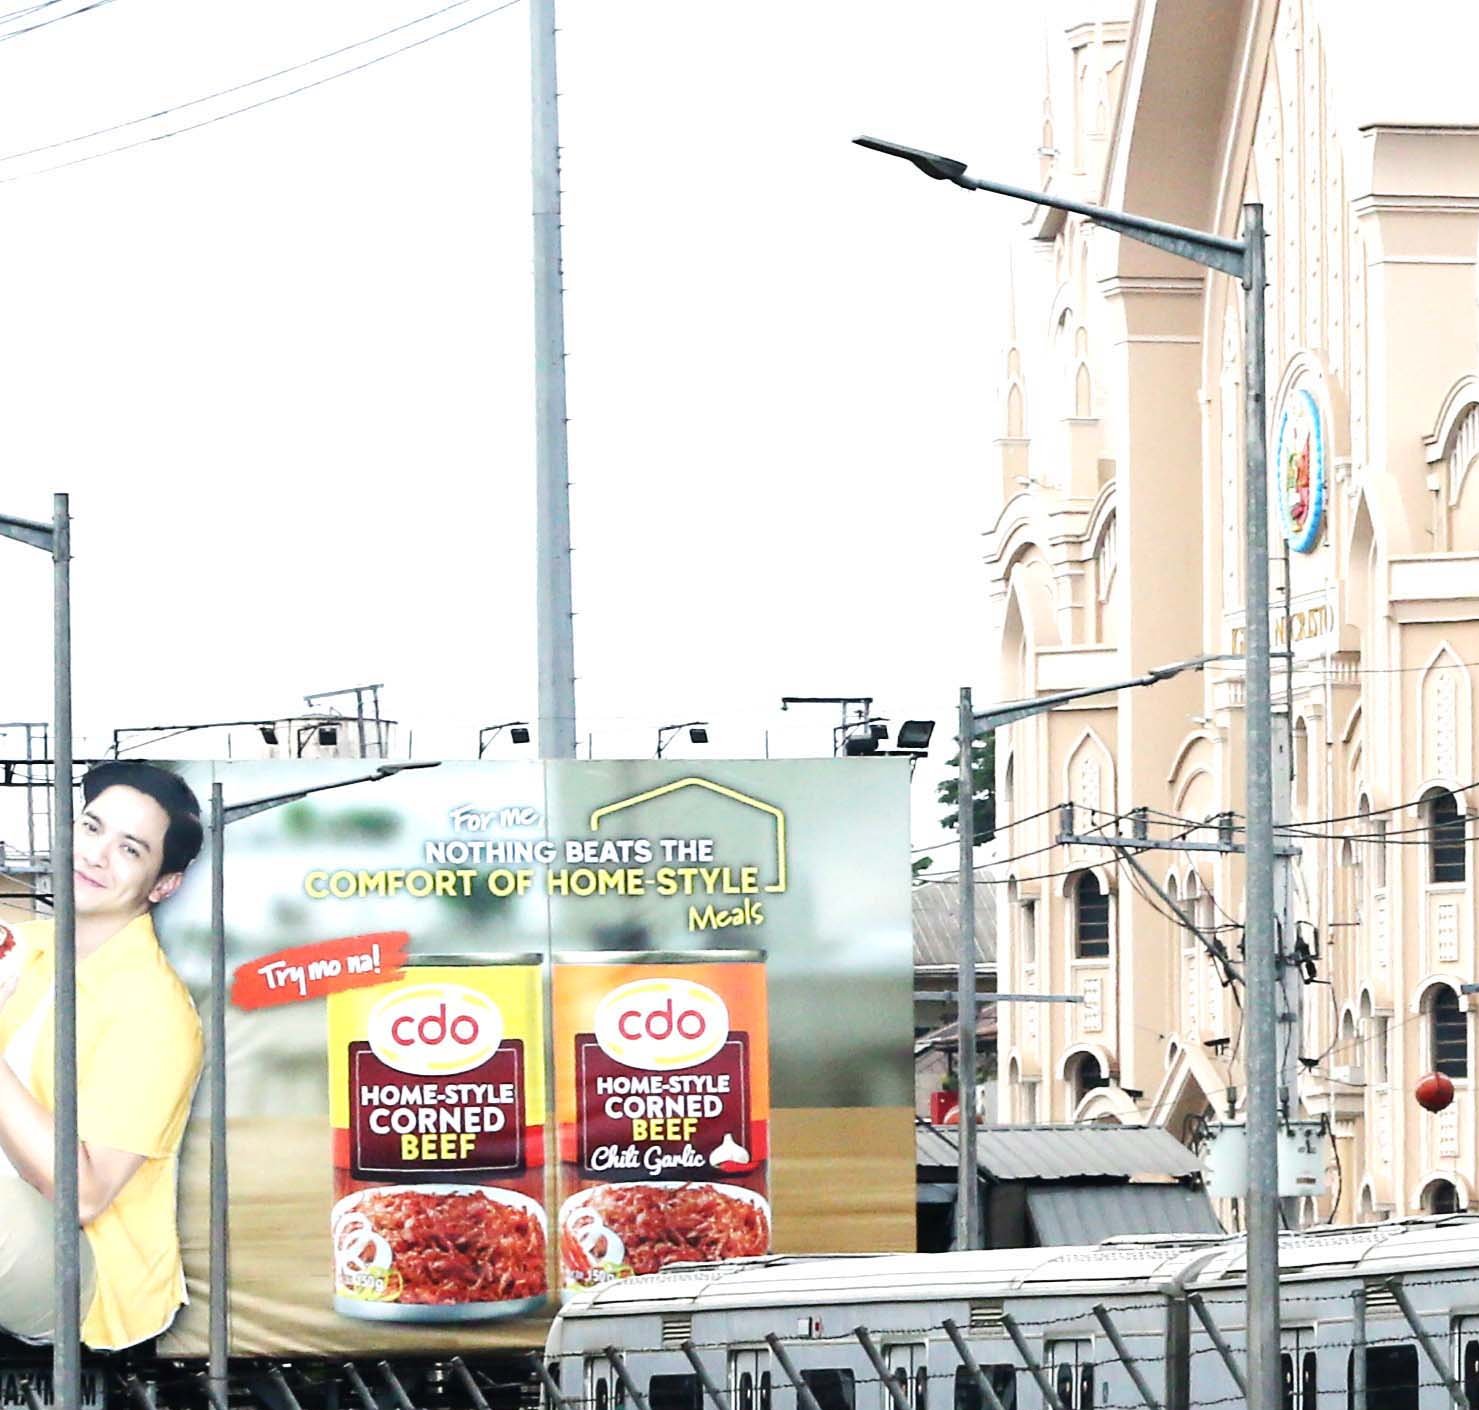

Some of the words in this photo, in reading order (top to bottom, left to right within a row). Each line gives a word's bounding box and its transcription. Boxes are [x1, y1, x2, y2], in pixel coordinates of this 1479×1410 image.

[449, 803, 496, 833] For
[425, 841, 556, 865] NOTHING
[566, 839, 652, 864] BEATS
[660, 838, 713, 863] THE
[304, 868, 478, 899] COMFORT
[487, 868, 534, 897] OF
[548, 866, 760, 897] HOME-STYLE
[688, 897, 765, 932] Meals
[257, 960, 307, 996] Try
[308, 958, 342, 981] mo
[346, 943, 381, 974] na!
[391, 1003, 479, 1046] cdo
[619, 998, 706, 1040] cdo
[360, 1083, 514, 1106] HOME-STYLE
[596, 1074, 731, 1095] HOME-STYLE
[368, 1106, 506, 1135] CORNED
[604, 1095, 723, 1119] CORNED
[632, 1118, 699, 1142] BEEF
[400, 1132, 477, 1161] BEEF
[590, 1144, 642, 1172] Chili
[643, 1143, 706, 1176] Garlic
